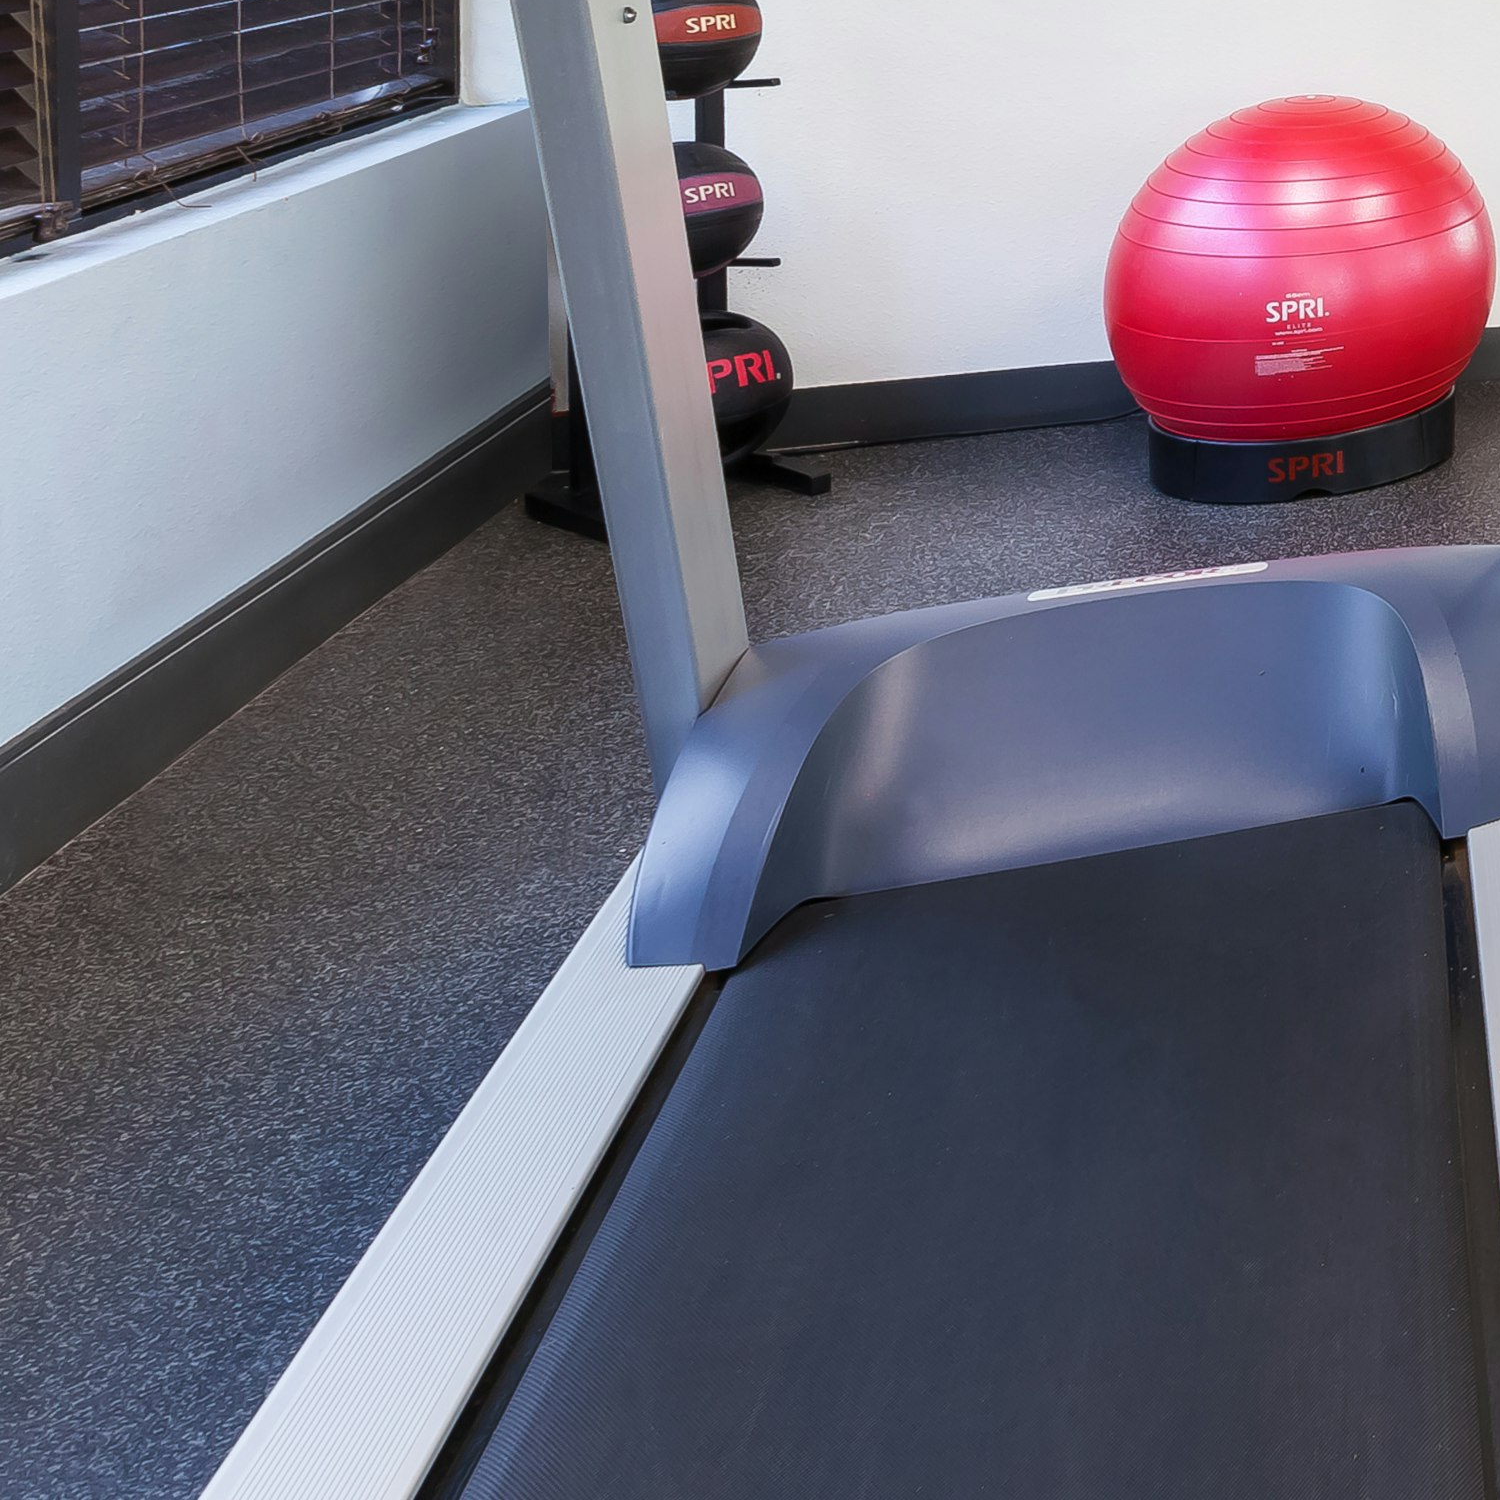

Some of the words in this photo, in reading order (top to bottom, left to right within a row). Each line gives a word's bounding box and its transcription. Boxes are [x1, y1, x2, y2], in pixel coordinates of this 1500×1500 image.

[685, 13, 737, 34] SPRI
[684, 182, 735, 204] SPRI
[1286, 322, 1312, 330] ELITE
[706, 349, 775, 395] PRI
[1267, 450, 1344, 484] SPRI
